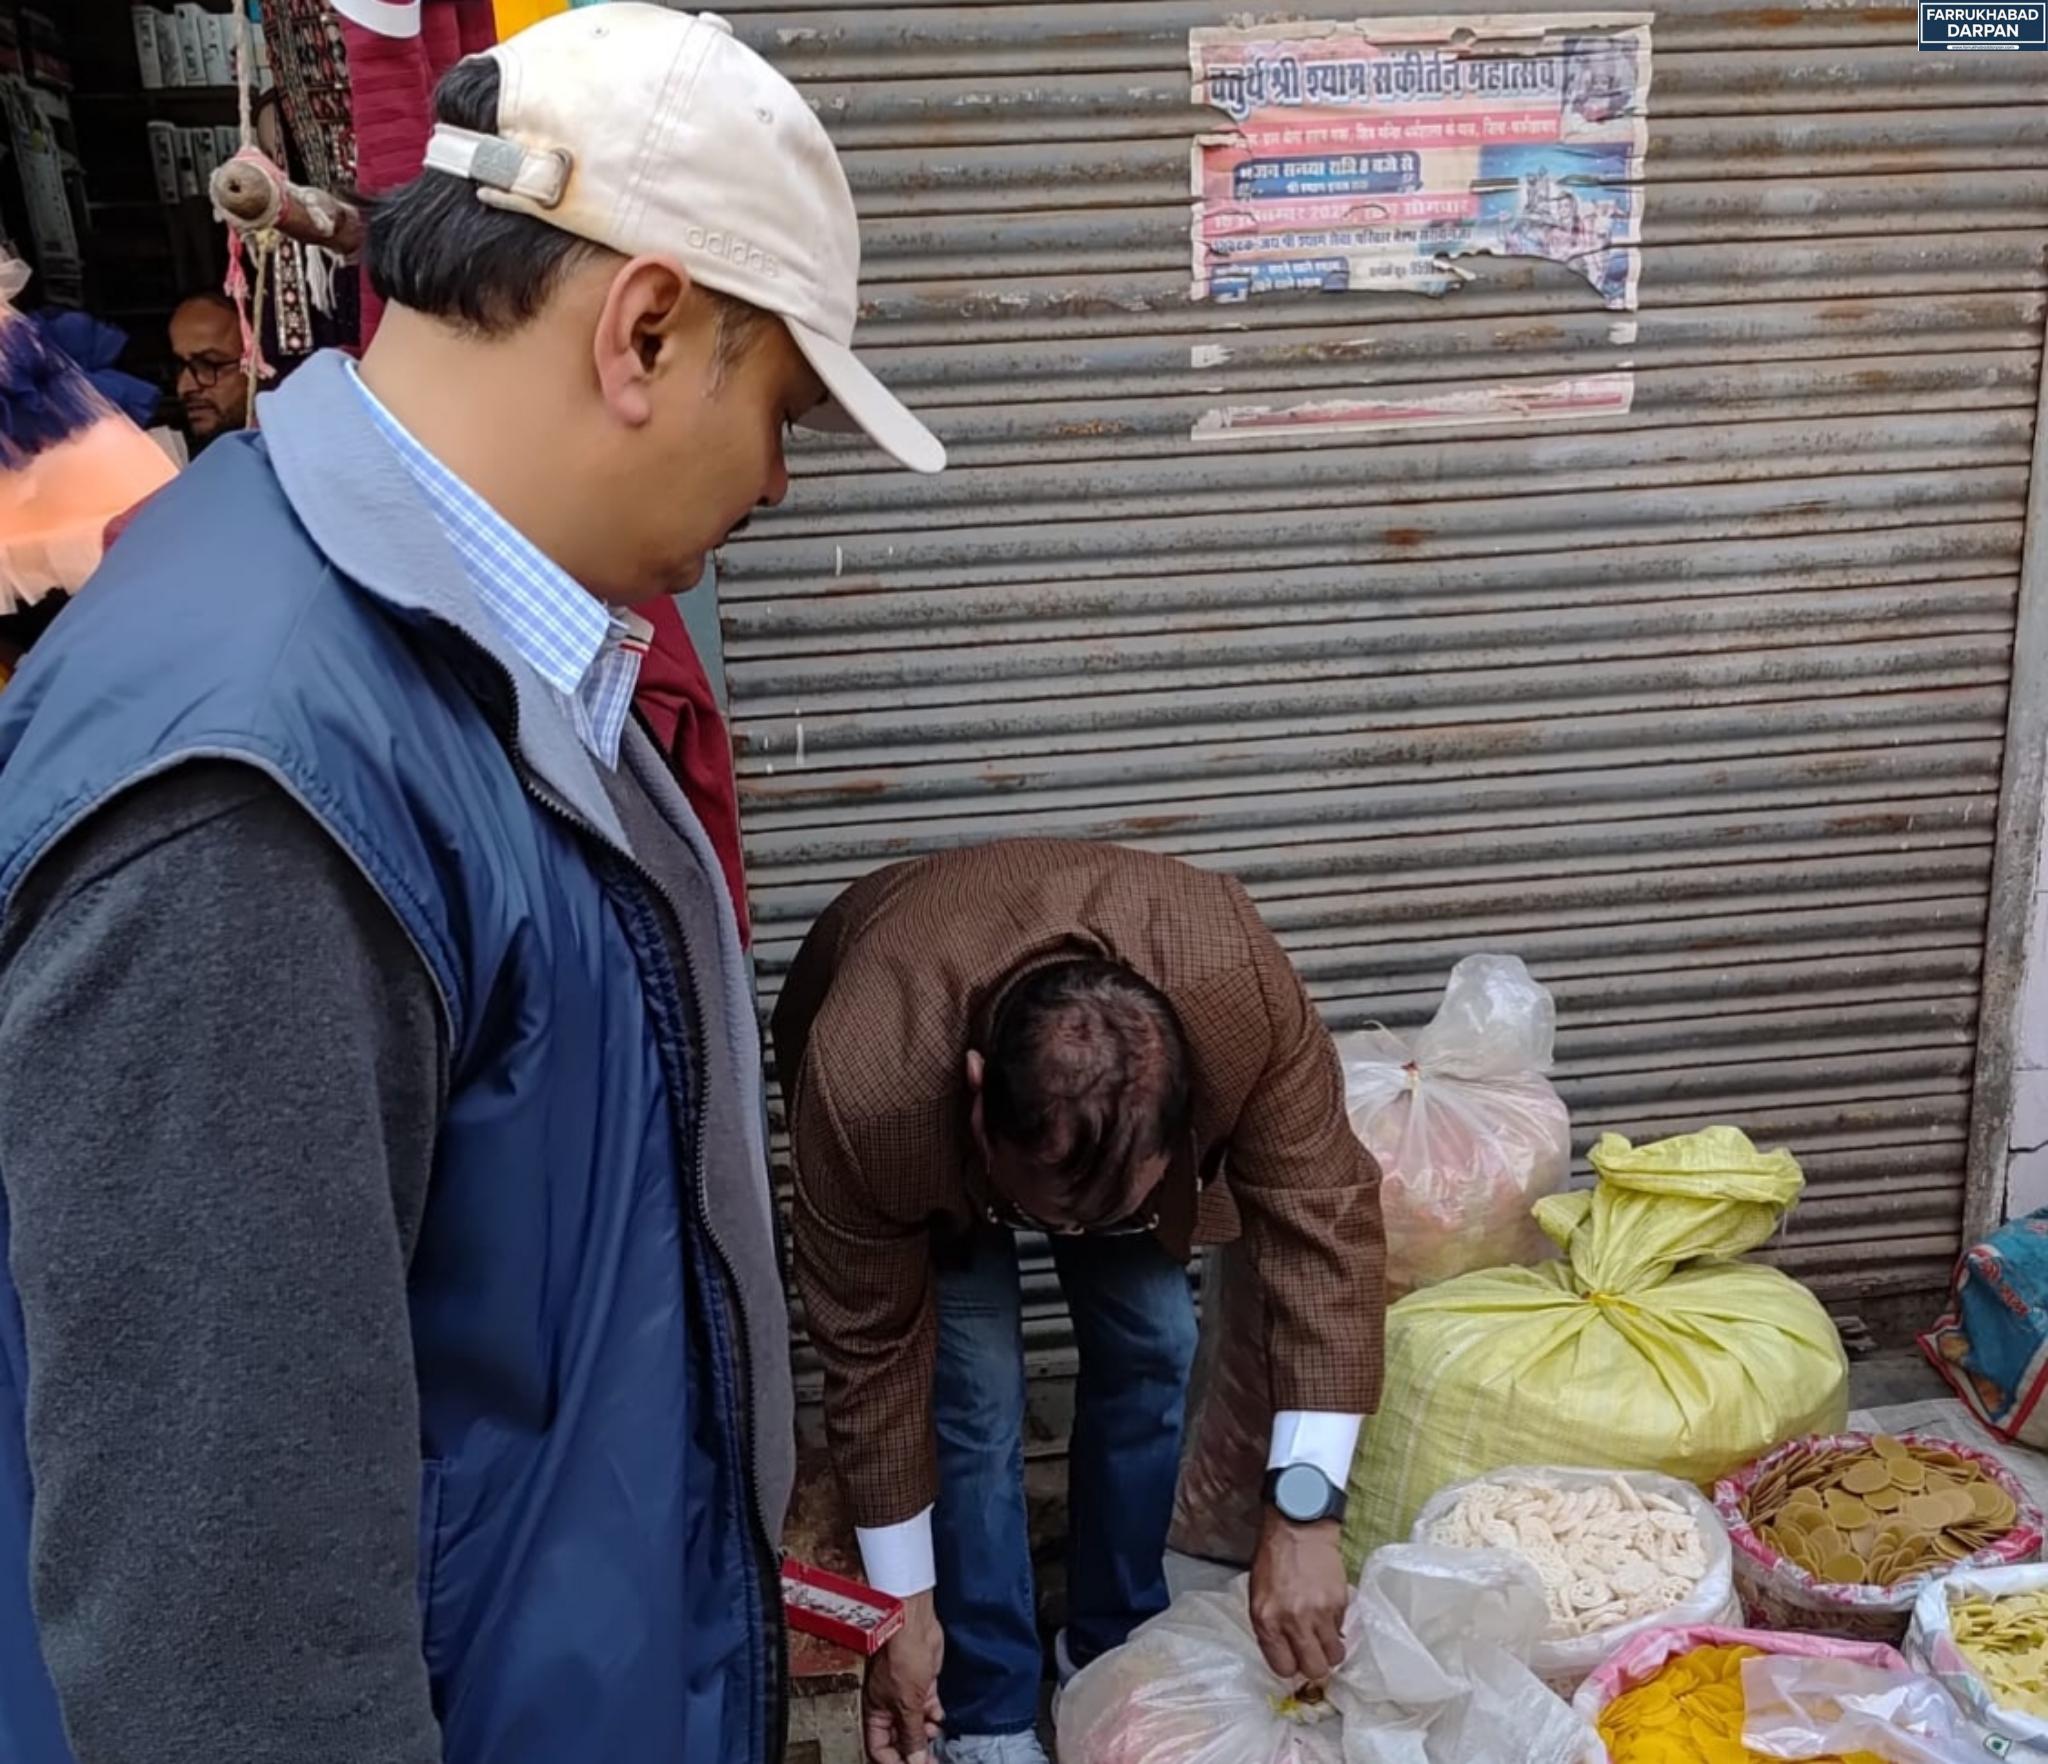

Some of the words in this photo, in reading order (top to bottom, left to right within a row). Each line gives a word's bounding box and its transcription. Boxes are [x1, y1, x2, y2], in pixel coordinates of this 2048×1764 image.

[1270, 57, 1300, 99] श्री
[1306, 62, 1367, 98] श्याम
[1371, 51, 1461, 96] संकीर्तन
[1371, 155, 1398, 173] बजे
[1401, 154, 1414, 172] से
[686, 225, 780, 278] adidas
